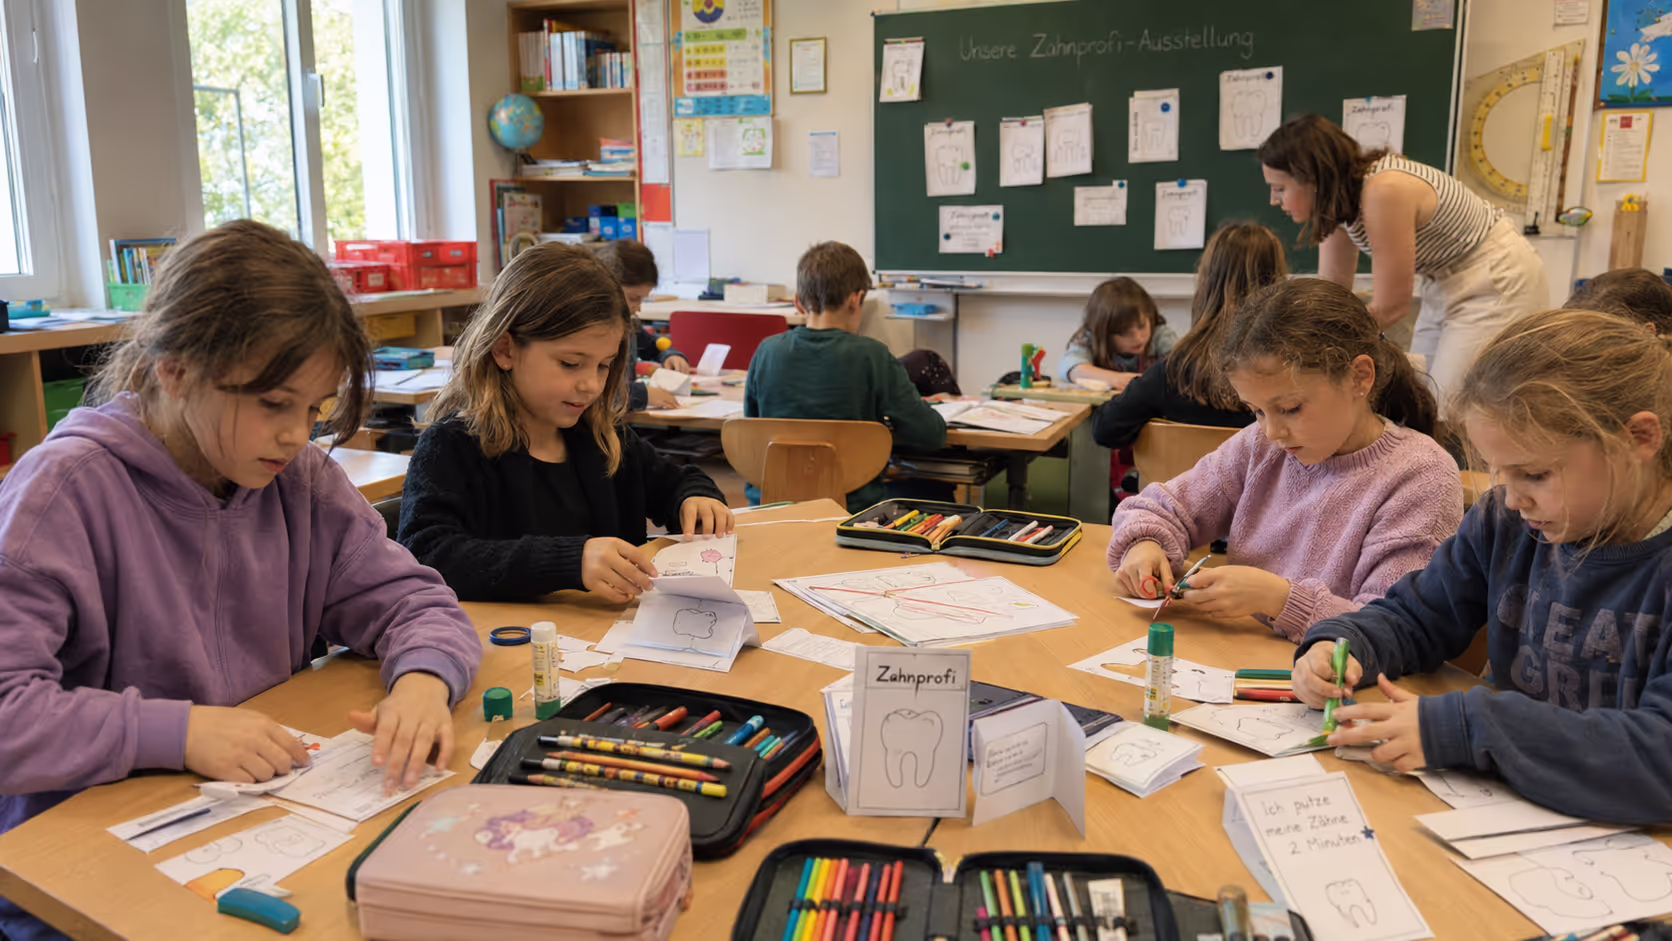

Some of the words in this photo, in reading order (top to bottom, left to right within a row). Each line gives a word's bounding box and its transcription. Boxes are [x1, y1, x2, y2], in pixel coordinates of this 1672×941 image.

[959, 34, 1018, 61] Unsere
[1030, 25, 1255, 70] Zahnprofi-Ausstellung
[876, 665, 957, 698] Zahnprofi
[1261, 801, 1284, 816] Ich
[1293, 795, 1332, 816] putze
[1265, 823, 1302, 837] meine
[1307, 815, 1349, 829] Zähne
[1289, 841, 1301, 855] 2
[1306, 834, 1360, 851] Minuten
